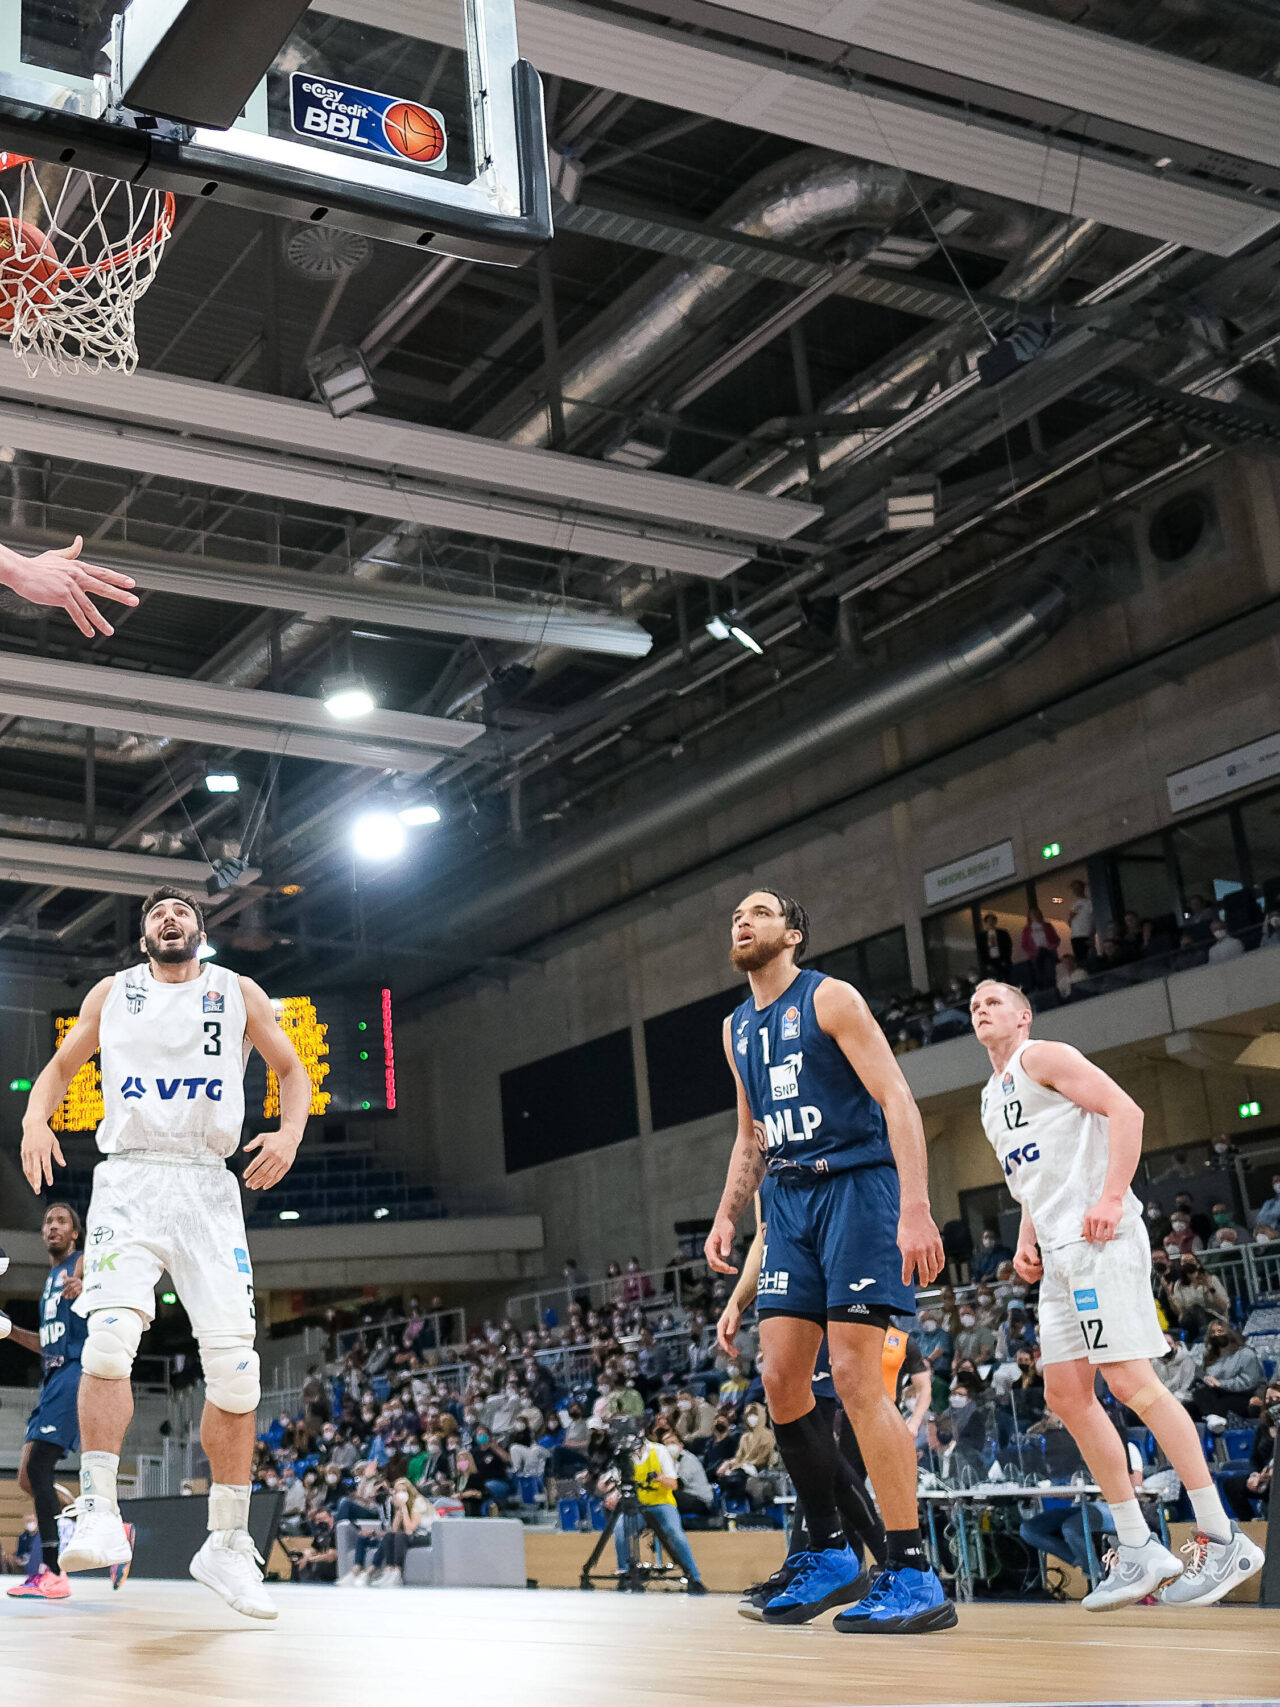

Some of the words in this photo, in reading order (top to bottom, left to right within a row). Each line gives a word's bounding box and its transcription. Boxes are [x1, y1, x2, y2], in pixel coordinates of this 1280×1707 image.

[303, 106, 369, 144] BBL
[203, 1021, 222, 1056] 3
[759, 1027, 770, 1065] 1
[155, 1078, 224, 1101] VTG
[774, 1083, 797, 1098] SNP
[764, 1105, 823, 1148] MLP
[1004, 1100, 1029, 1131] 12
[1080, 1318, 1108, 1351] 12
